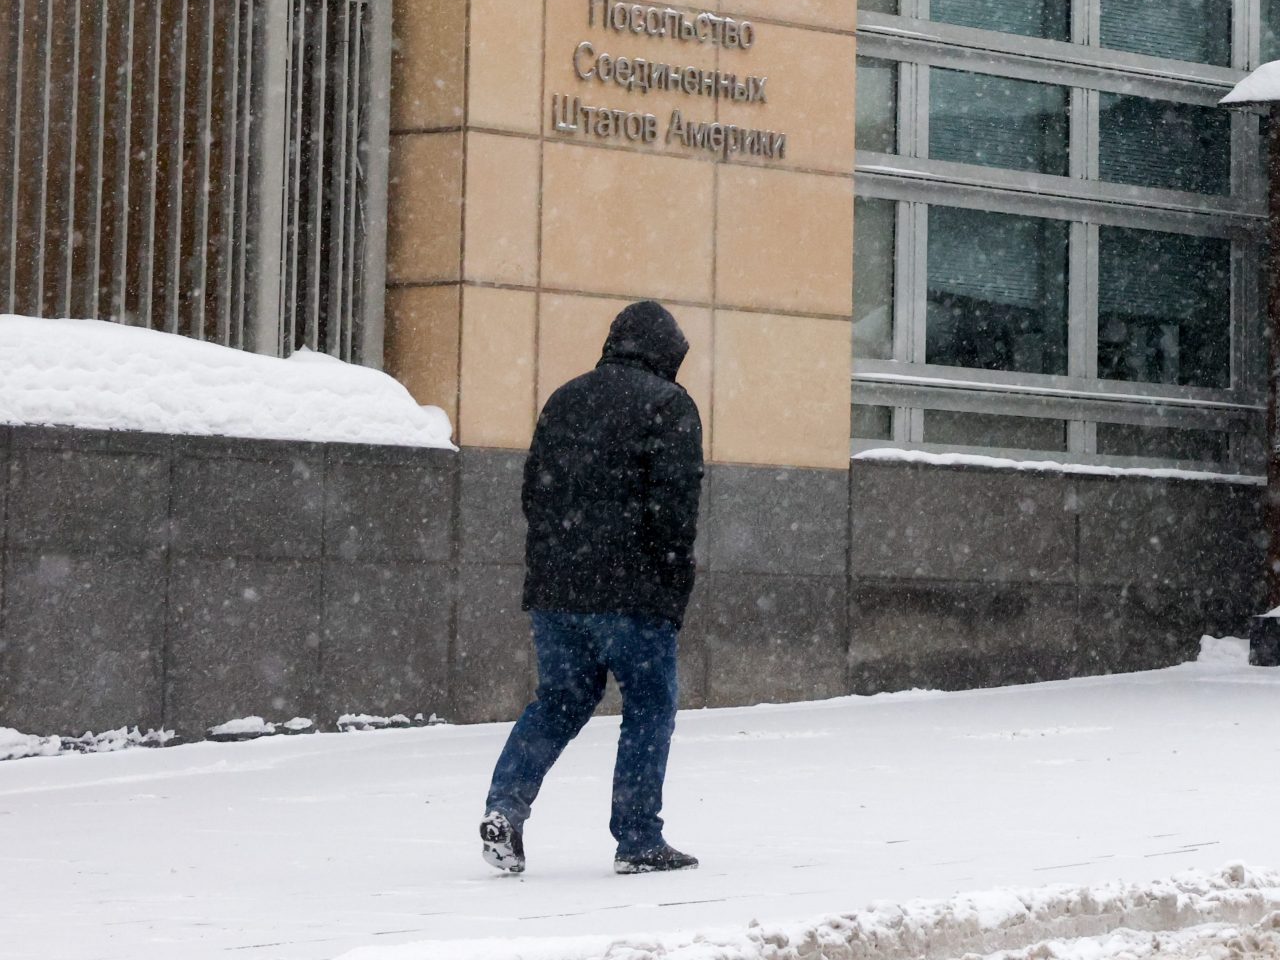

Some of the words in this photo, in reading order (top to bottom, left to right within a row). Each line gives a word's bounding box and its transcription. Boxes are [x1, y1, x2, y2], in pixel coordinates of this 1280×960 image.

[573, 41, 768, 104] Соединенных
[551, 93, 658, 142] Штатов
[666, 109, 786, 162] Америки
